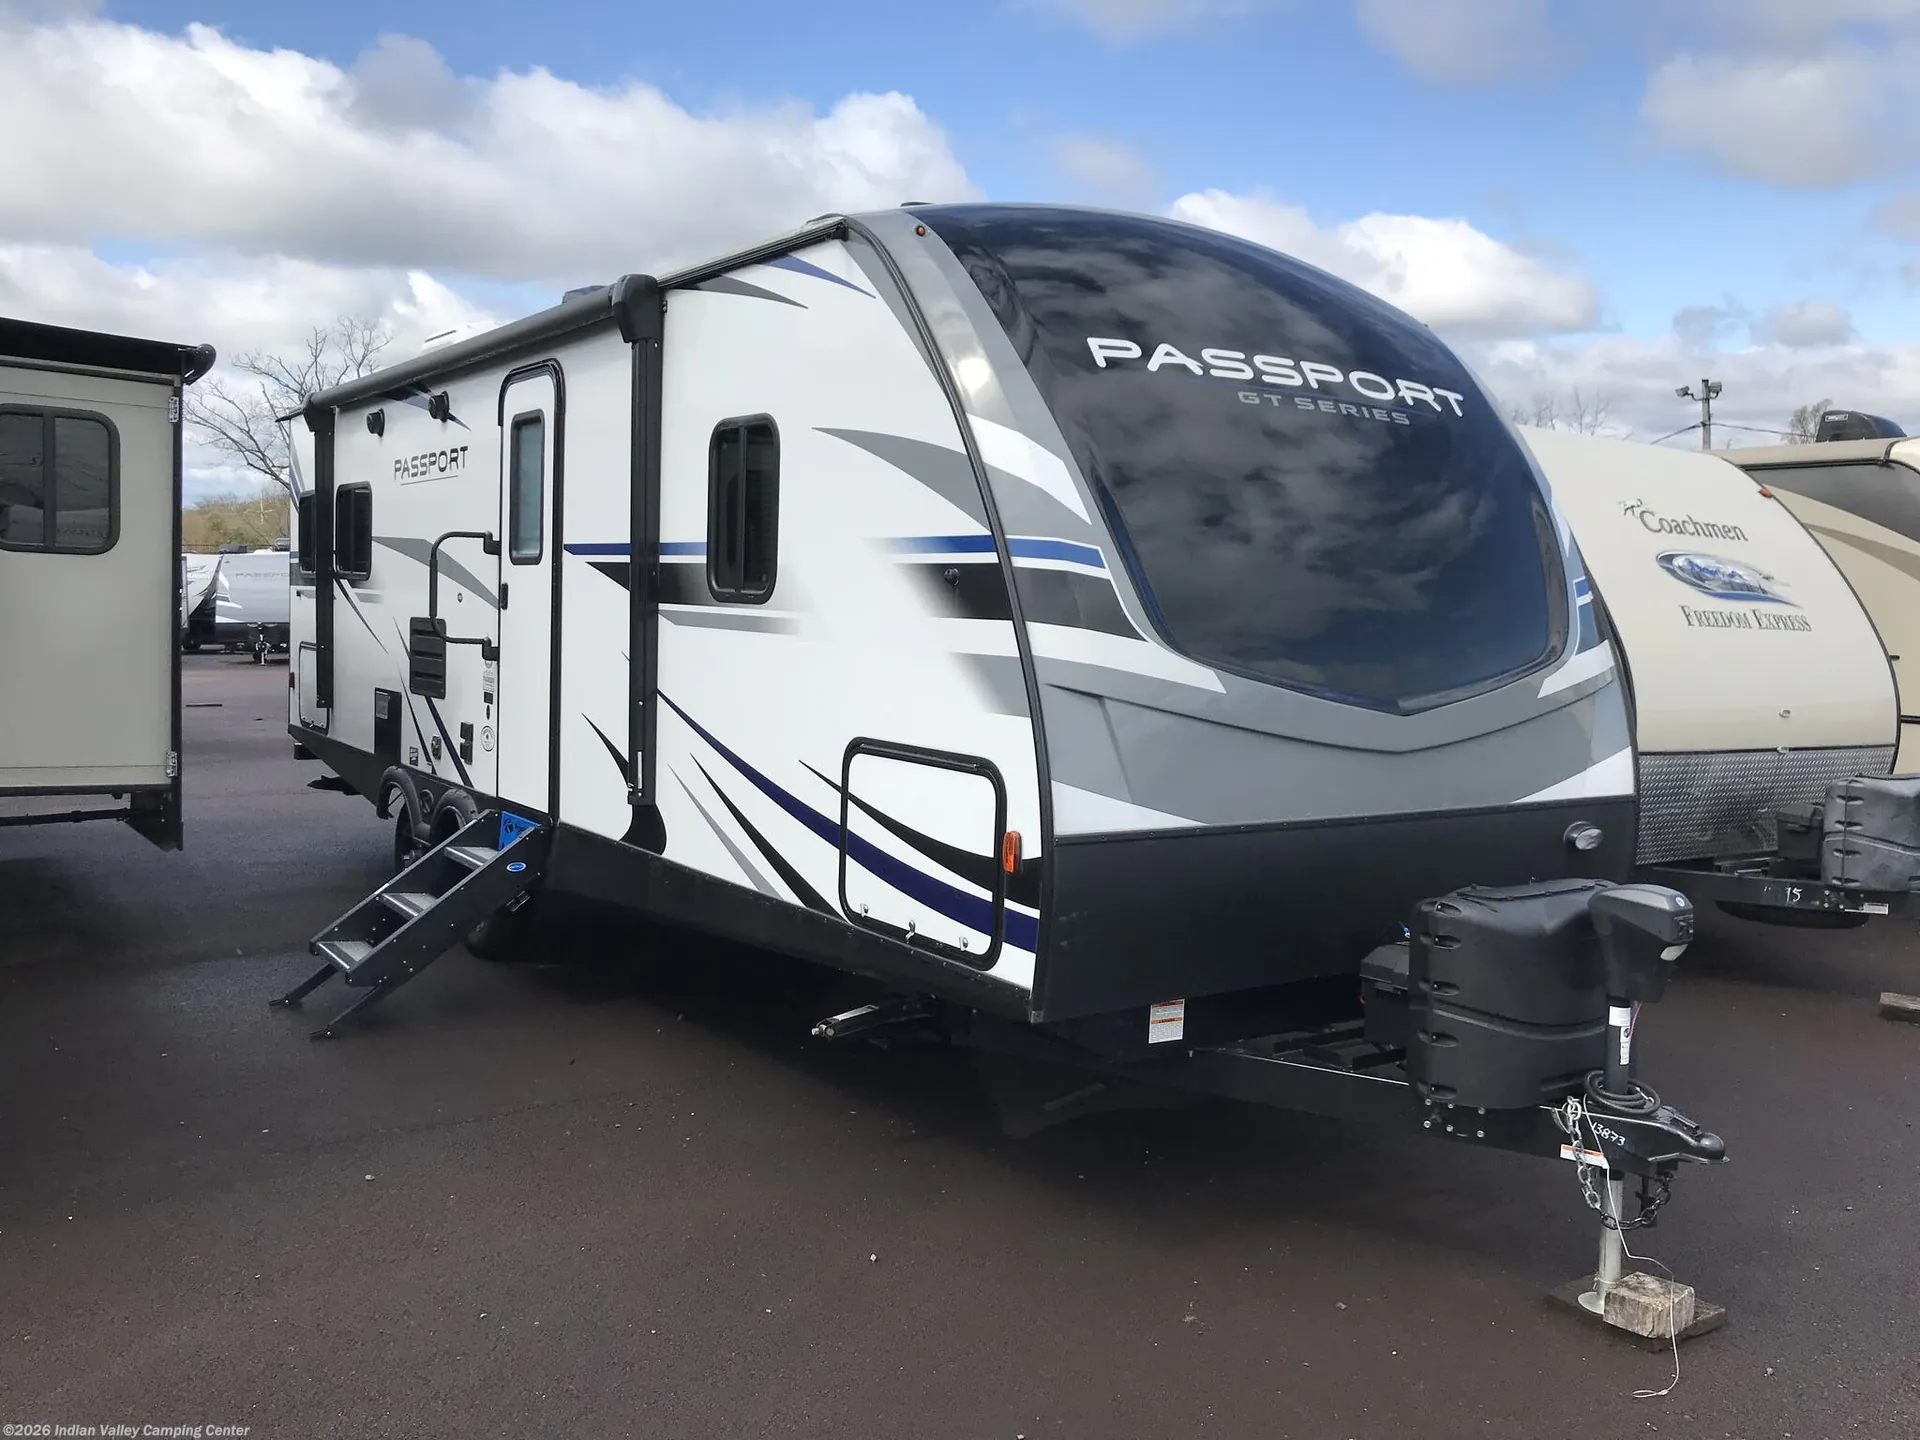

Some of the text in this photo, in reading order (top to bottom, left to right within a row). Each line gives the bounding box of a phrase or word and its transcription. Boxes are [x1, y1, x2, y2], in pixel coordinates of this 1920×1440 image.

[1086, 337, 1464, 417] PASSPORT
[1237, 390, 1410, 425] GT SERIES
[394, 446, 468, 480] PASSPORT
[1639, 509, 1749, 542] Coachmen
[1680, 605, 1812, 632] FREEDOM EXPRESS
